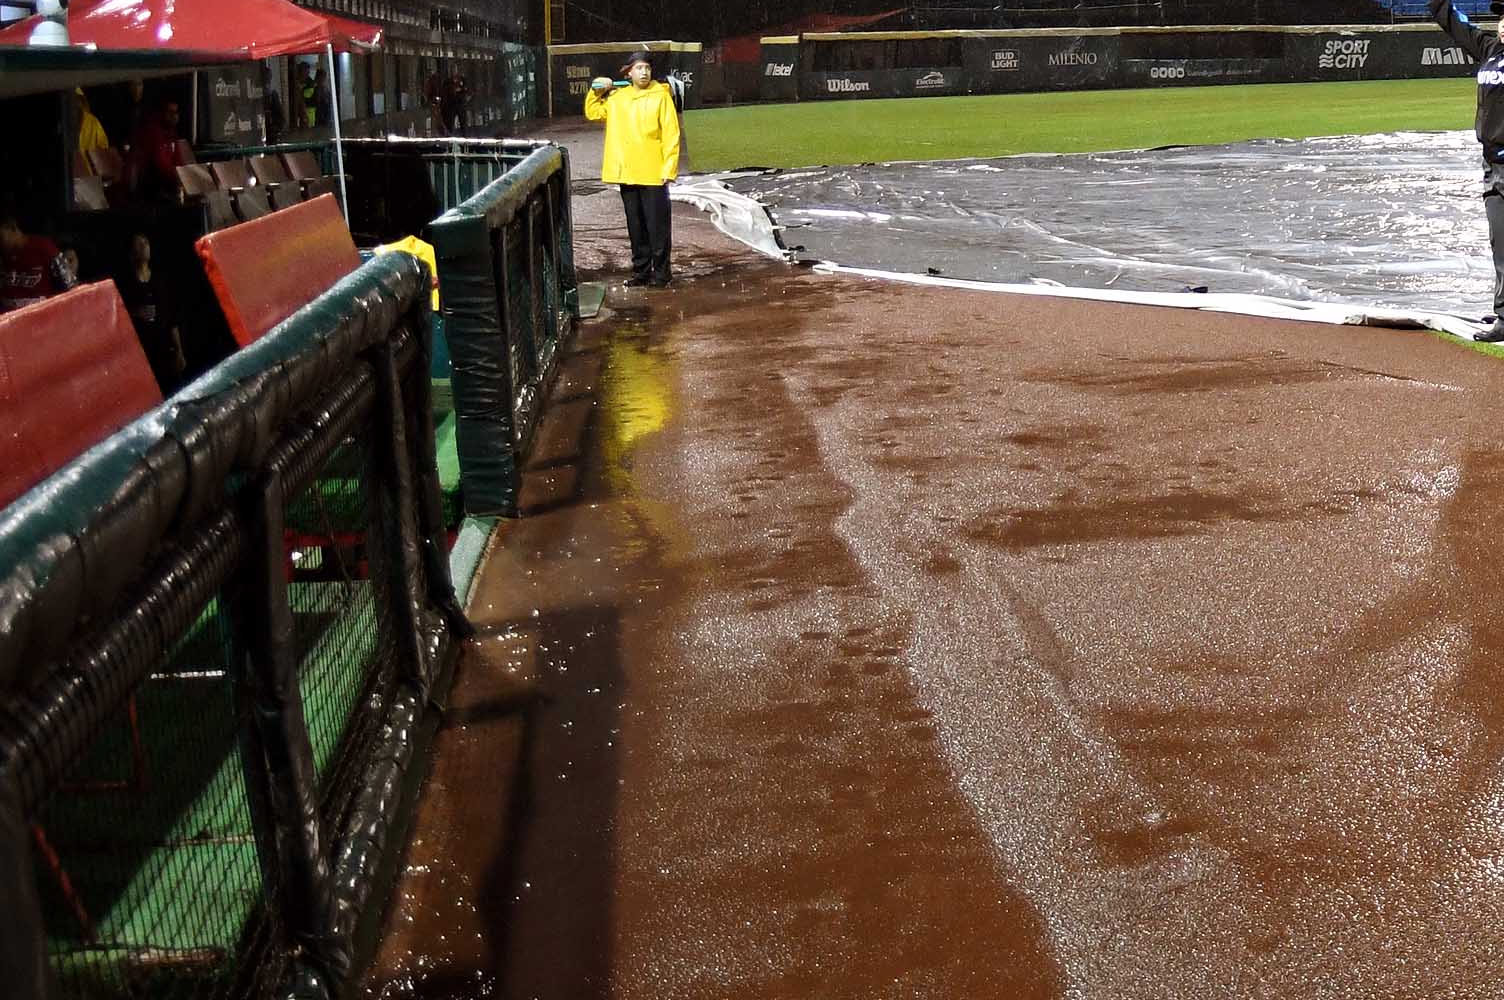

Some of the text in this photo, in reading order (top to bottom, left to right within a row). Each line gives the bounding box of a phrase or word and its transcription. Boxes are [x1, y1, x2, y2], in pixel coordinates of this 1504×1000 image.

[1325, 40, 1370, 54] SPORT
[995, 52, 1014, 60] BUD
[1048, 53, 1097, 66] MILENIO
[1334, 54, 1368, 69] CITY
[992, 60, 1018, 68] LIGHT
[827, 79, 870, 92] Wilson
